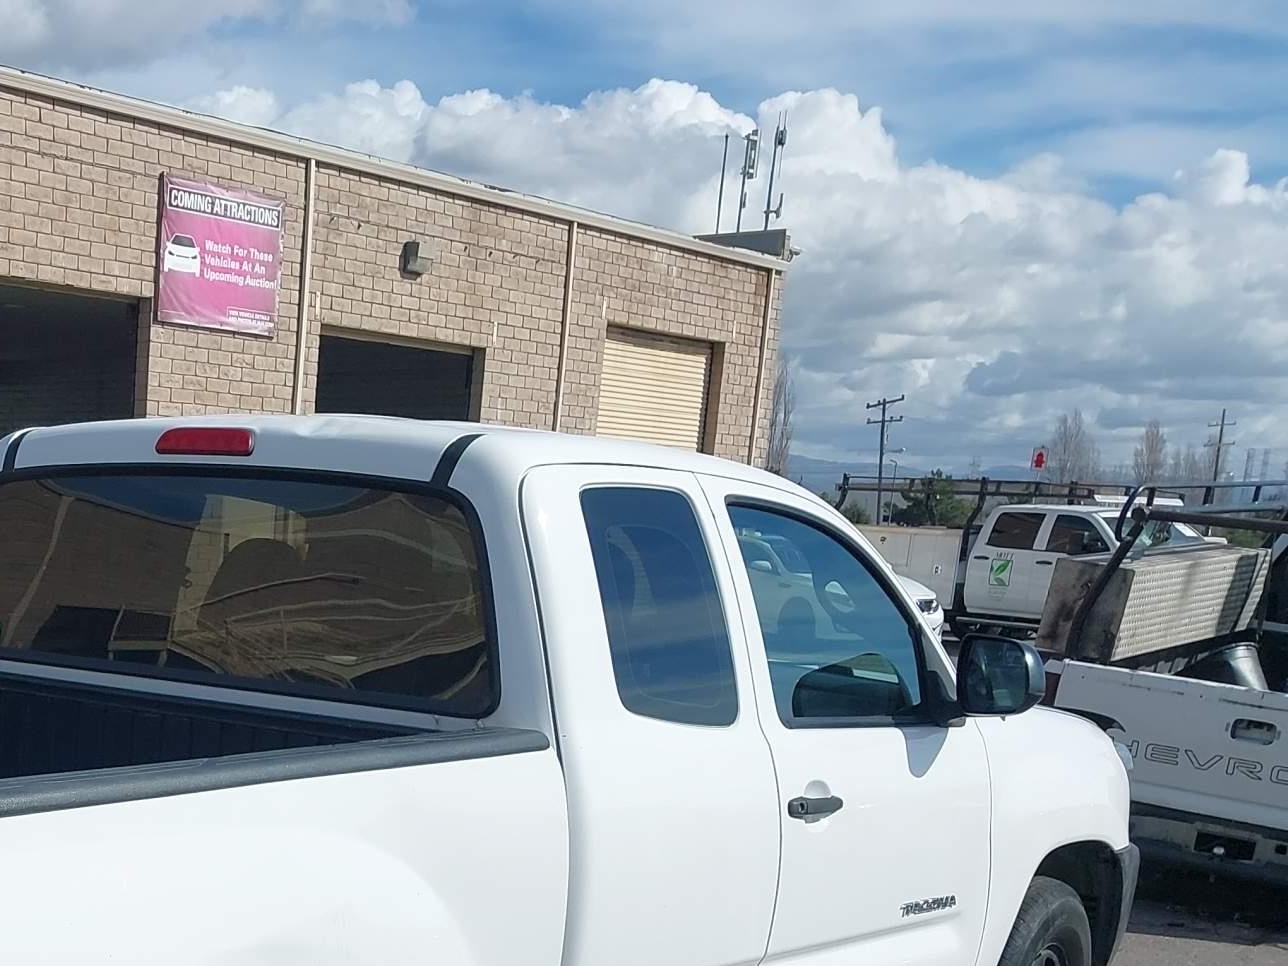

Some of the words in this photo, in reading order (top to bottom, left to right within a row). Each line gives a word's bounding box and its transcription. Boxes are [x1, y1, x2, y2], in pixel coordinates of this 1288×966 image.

[171, 189, 212, 213] COMING
[213, 199, 279, 226] ATTRACTIONS
[205, 239, 232, 255] Watch
[233, 244, 248, 257] For
[249, 247, 273, 262] These
[204, 253, 240, 270] Vehicles
[242, 260, 253, 272] At
[254, 262, 266, 274] An
[203, 267, 244, 286] Upcoming
[899, 894, 956, 918] TACOMA
